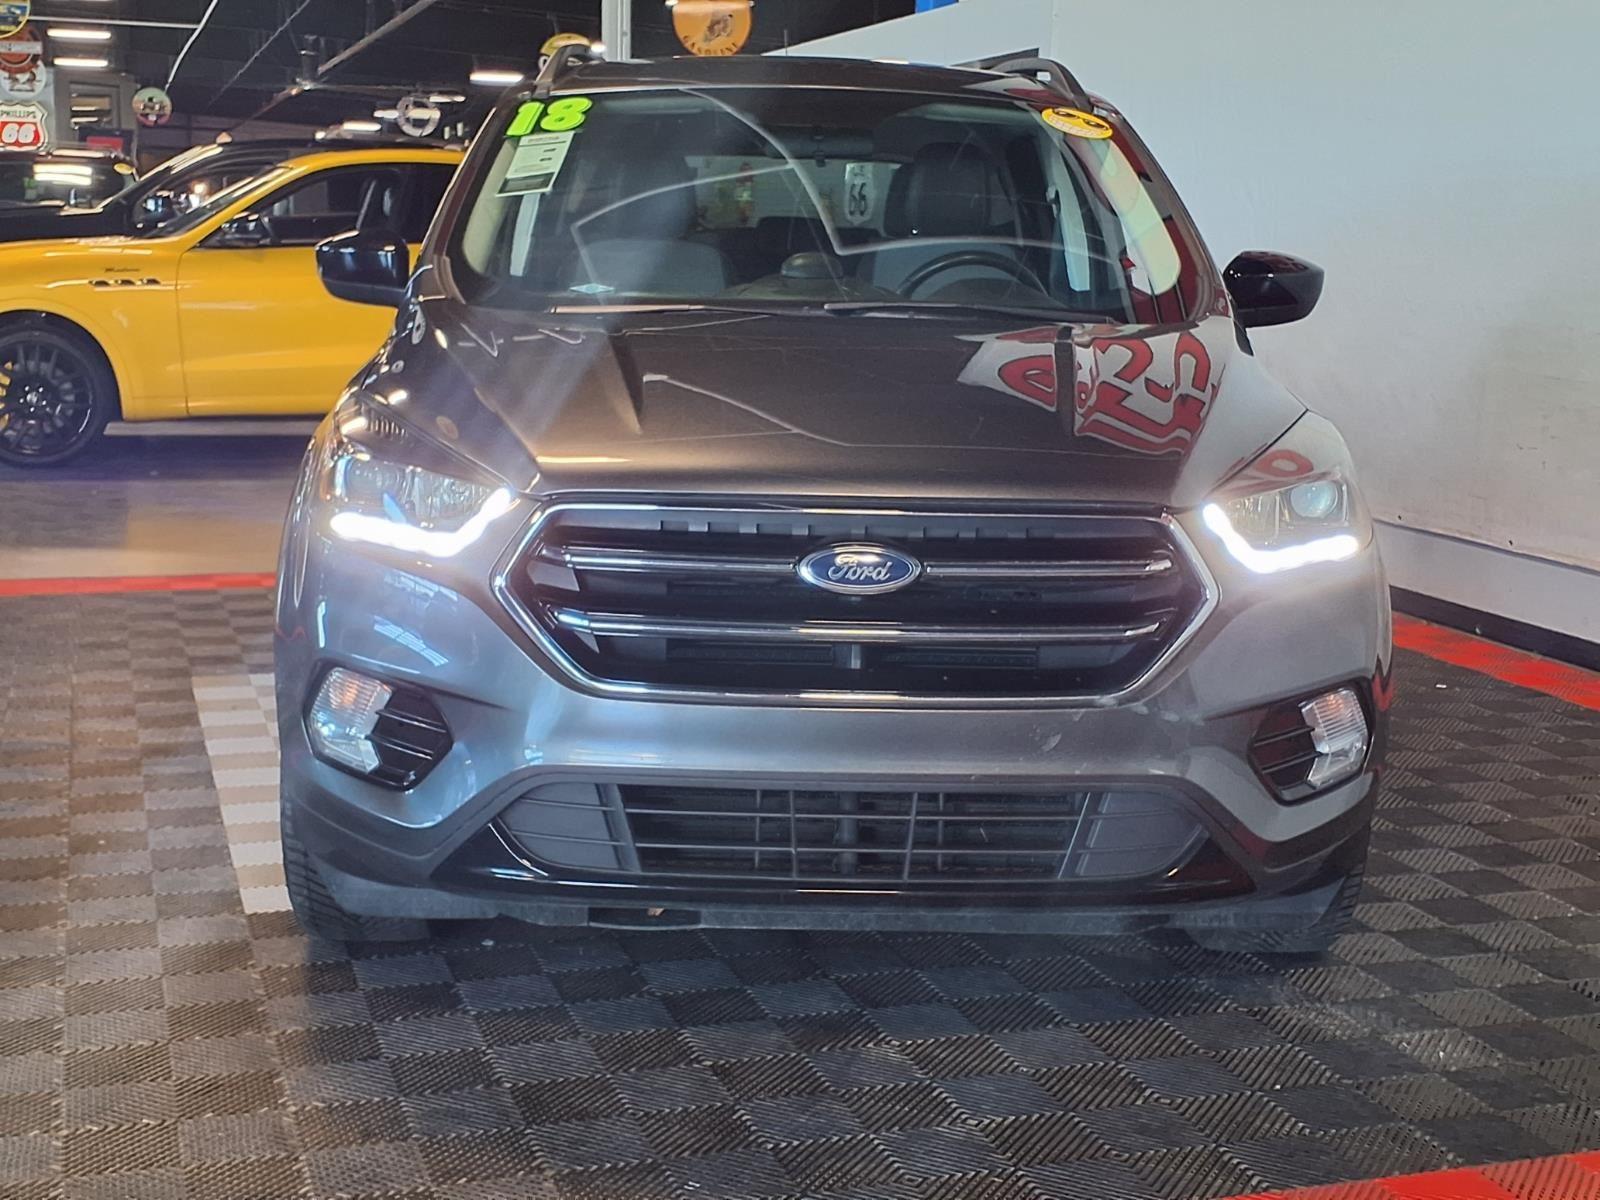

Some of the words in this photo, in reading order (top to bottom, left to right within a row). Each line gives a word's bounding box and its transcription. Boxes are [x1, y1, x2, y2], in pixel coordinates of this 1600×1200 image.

[506, 97, 593, 136] 18
[1, 122, 36, 144] 66
[828, 553, 893, 580] Ford
